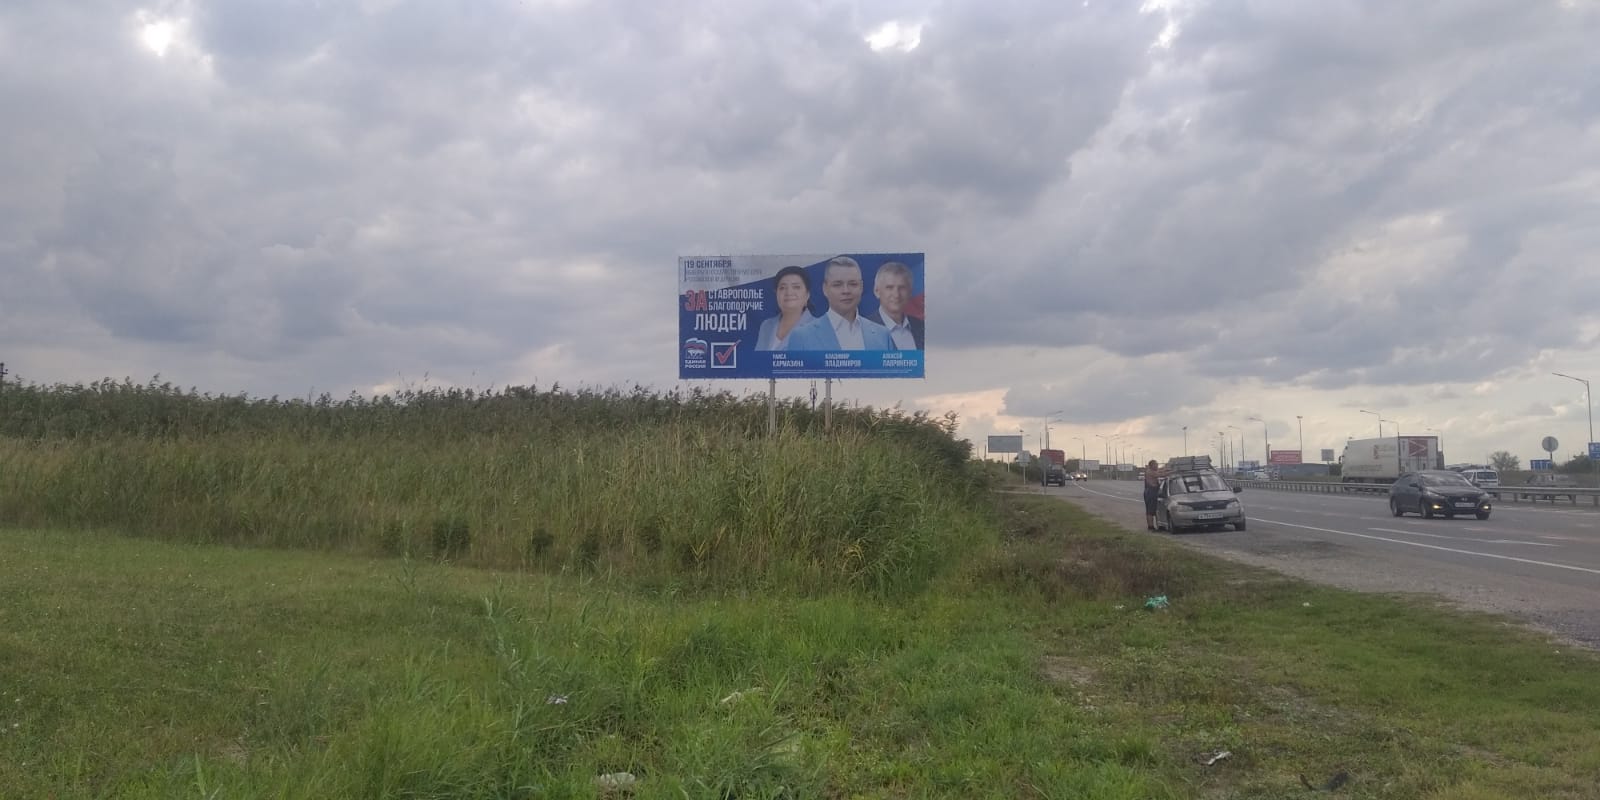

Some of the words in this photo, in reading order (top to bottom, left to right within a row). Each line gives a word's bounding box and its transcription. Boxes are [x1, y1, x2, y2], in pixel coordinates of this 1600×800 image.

[687, 260, 695, 269] 19
[696, 259, 732, 269] СЕНТЯБРЯ
[685, 289, 708, 311] ЗА
[708, 288, 764, 299] СТАВРОПОЛЬЕ
[708, 301, 764, 311] БЛАГОПОЛУЧИЕ
[694, 310, 747, 332] ЛЮДЕЙ
